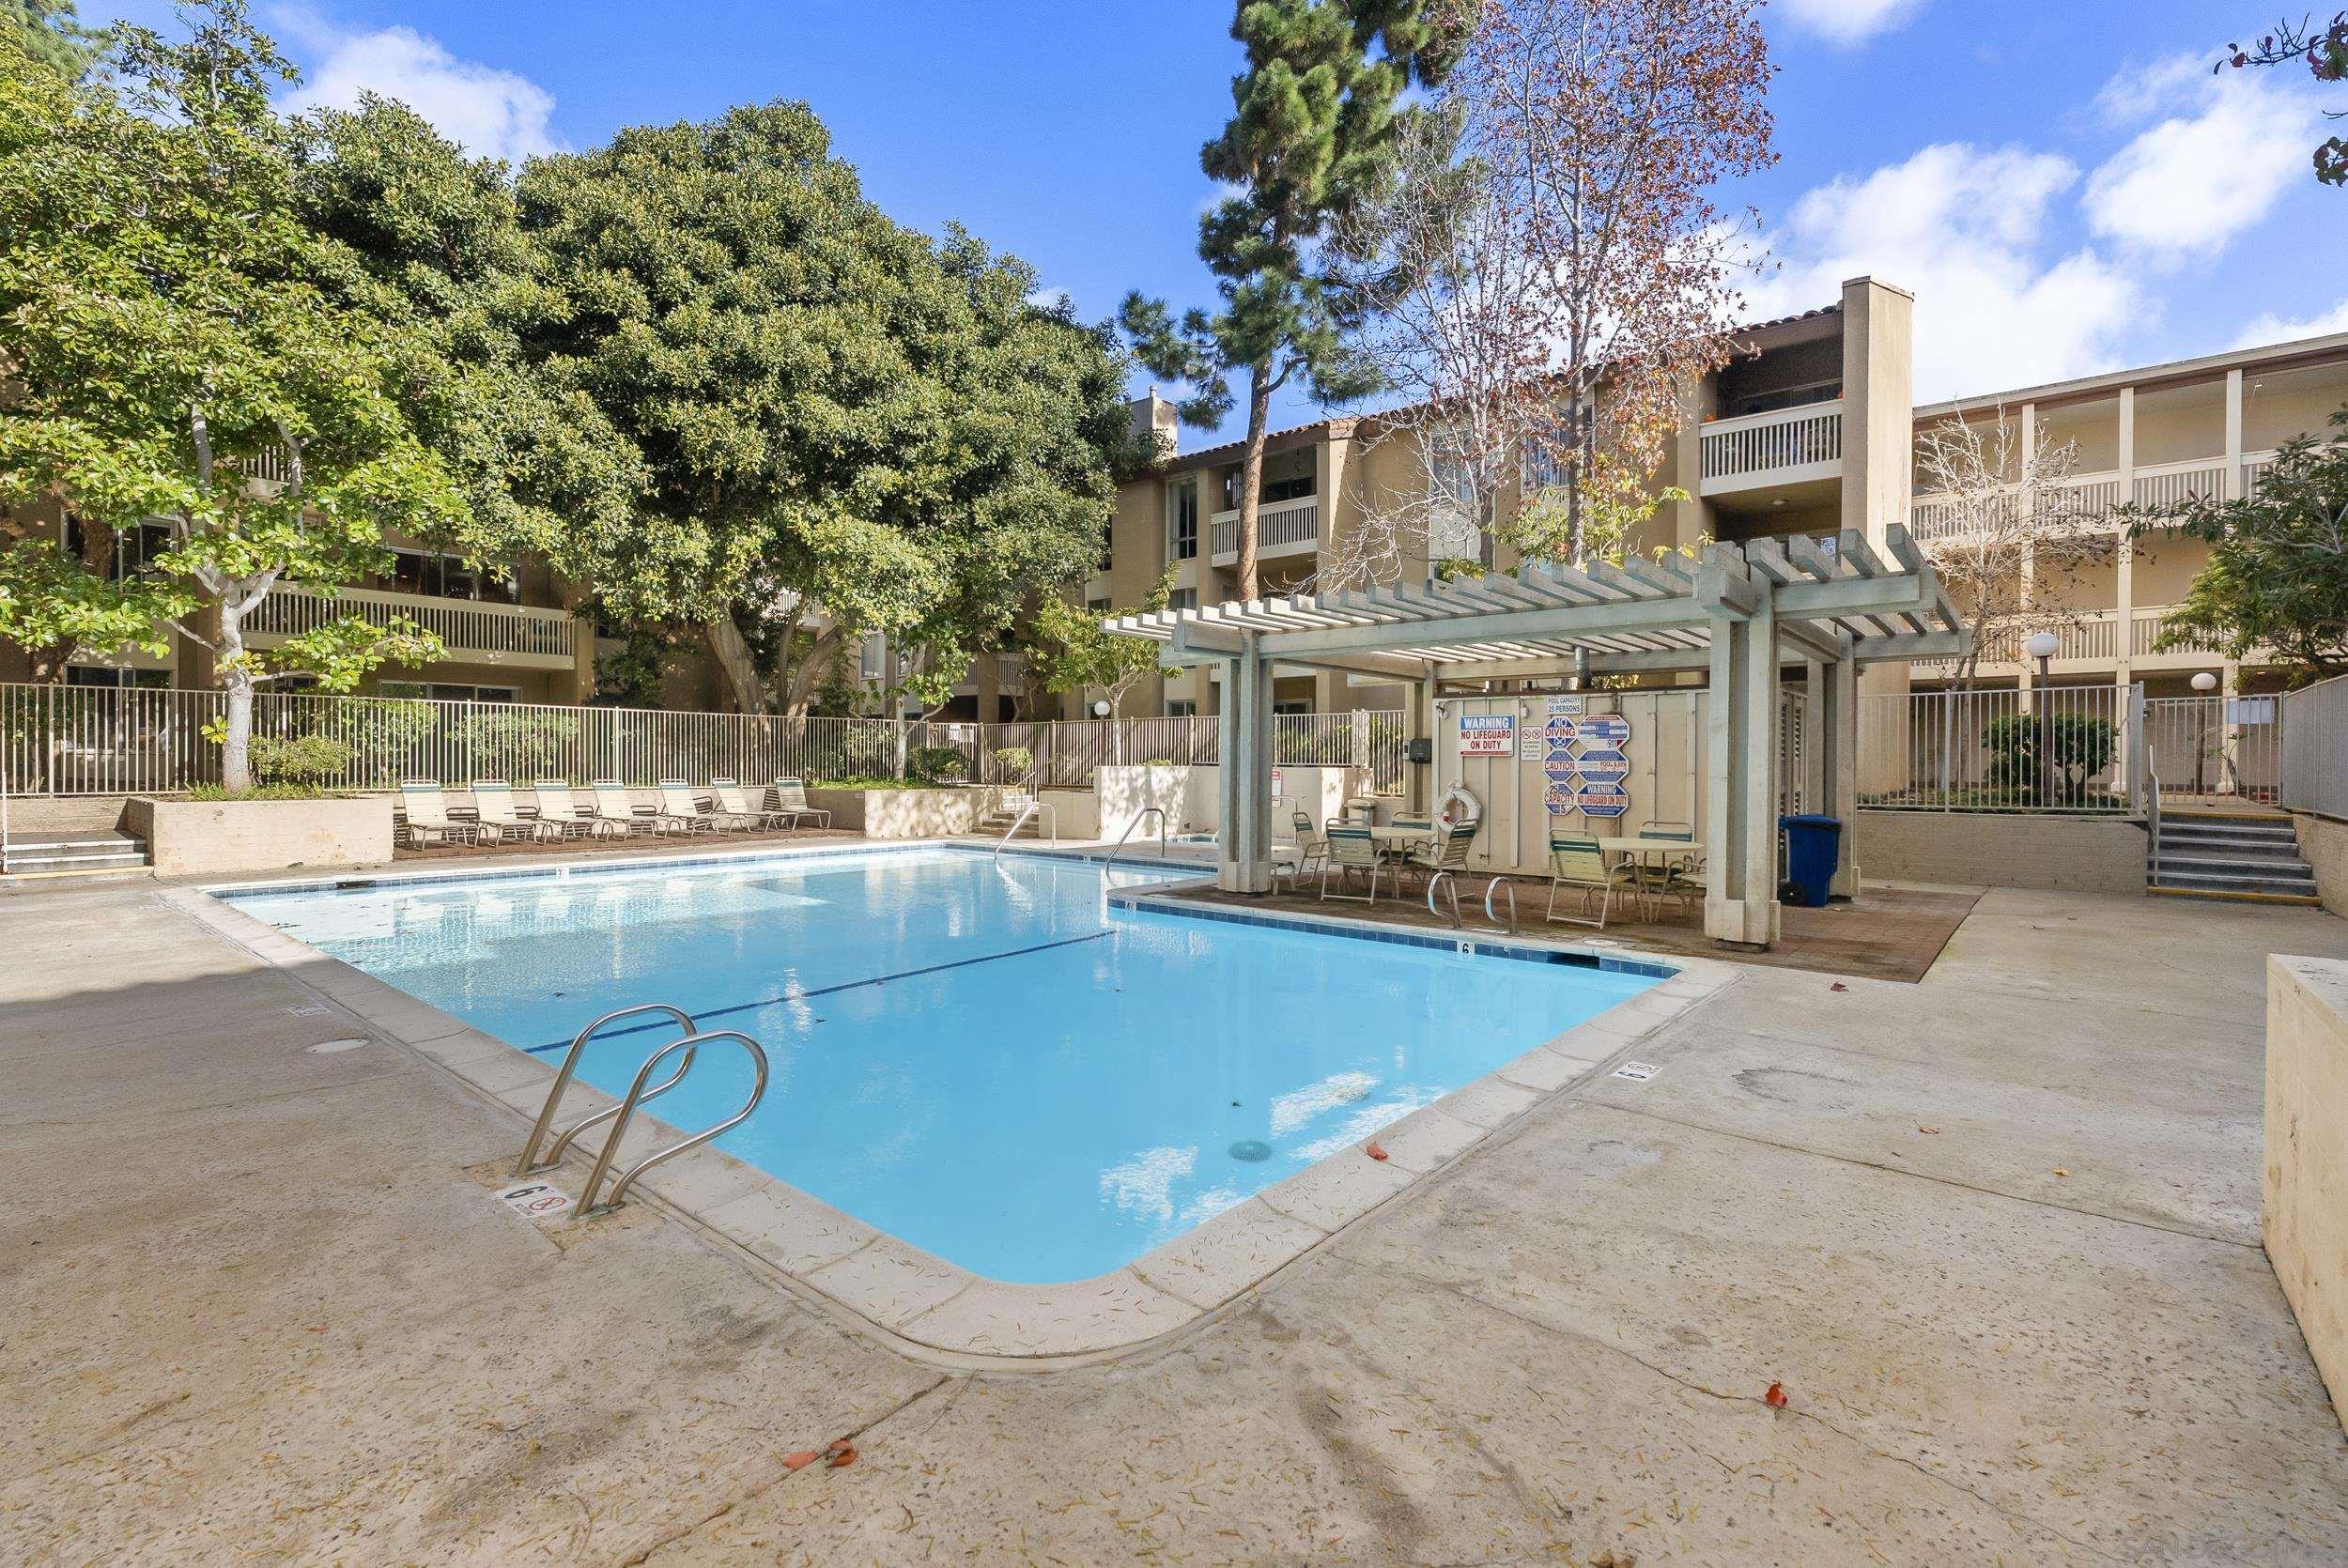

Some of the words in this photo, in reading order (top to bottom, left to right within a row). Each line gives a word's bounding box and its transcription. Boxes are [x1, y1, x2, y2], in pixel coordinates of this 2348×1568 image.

[1464, 717, 1509, 729] WARNING
[1553, 718, 1568, 728] NO
[1460, 730, 1471, 740] NO
[1473, 730, 1511, 740] LIFEGUARD
[1545, 729, 1576, 737] DIVING
[1470, 741, 1480, 749] ON
[1483, 740, 1502, 749] DUTY
[1544, 761, 1575, 771] CAUTION
[1549, 785, 1558, 794] 25
[1587, 783, 1617, 794] WARNING
[1544, 793, 1575, 804] CAPACITY
[1577, 794, 1584, 805] NO
[1584, 794, 1607, 805] LIFEGUARD
[1608, 795, 1614, 805] ON
[1615, 795, 1627, 806] DUTY
